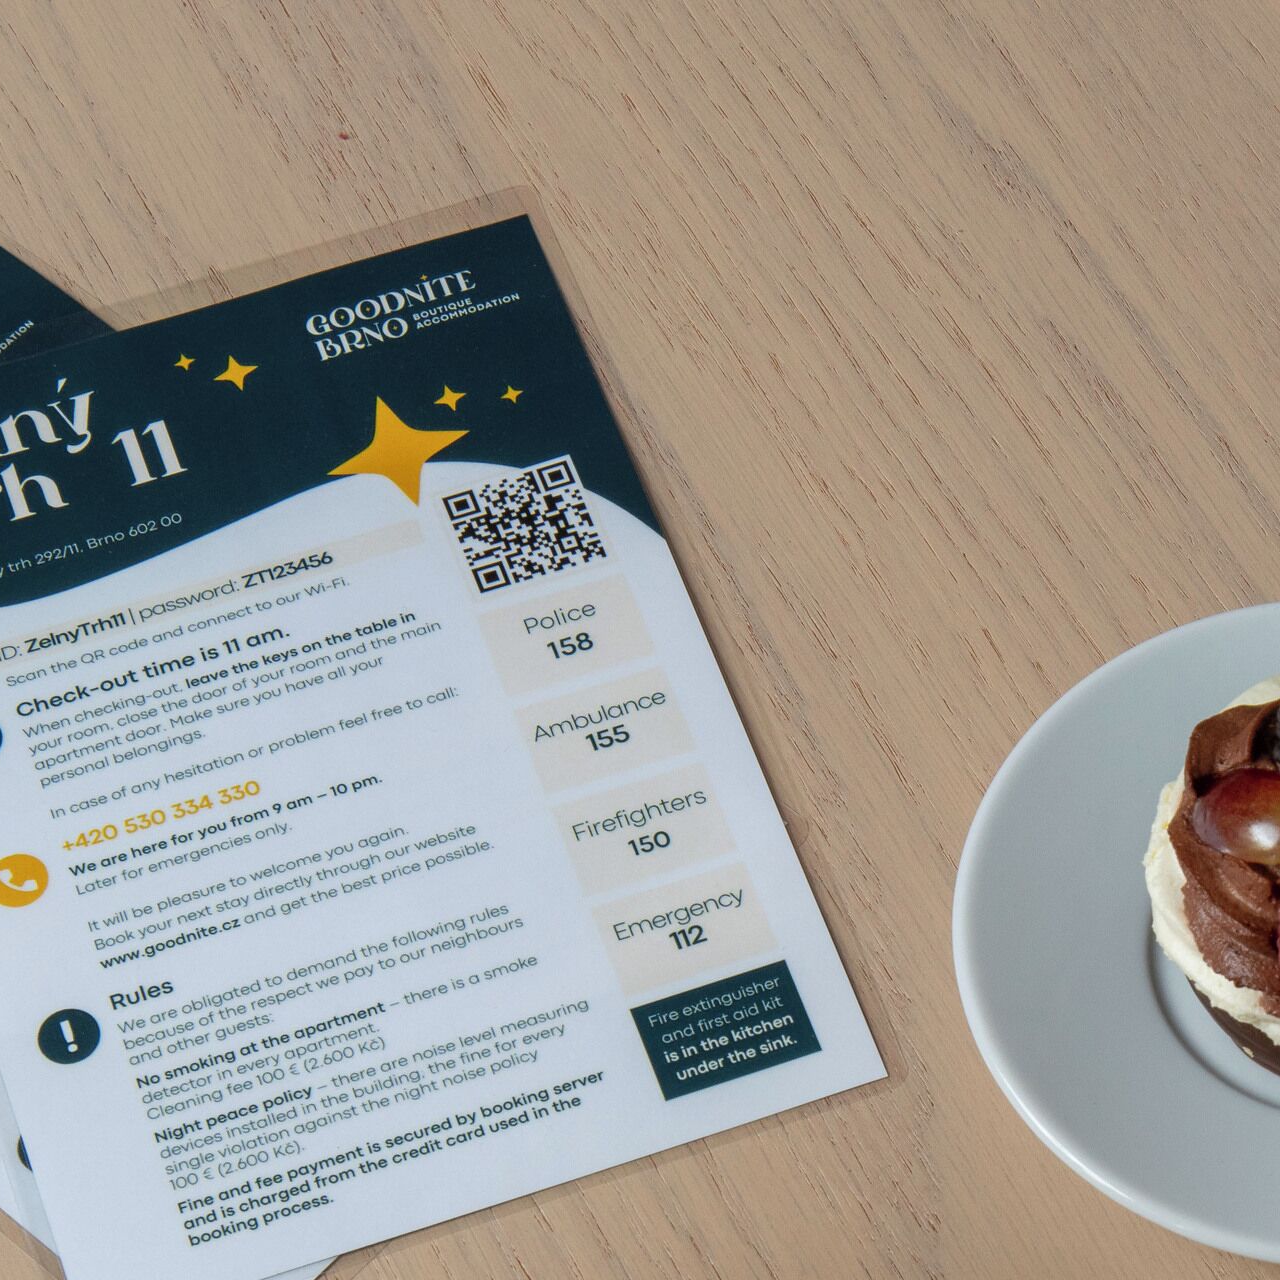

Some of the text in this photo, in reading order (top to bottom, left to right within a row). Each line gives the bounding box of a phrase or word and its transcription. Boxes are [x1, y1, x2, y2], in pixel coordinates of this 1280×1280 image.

[412, 297, 472, 321] BOUTIQUE
[416, 293, 520, 329] ACCOMMODATION
[314, 317, 408, 361] BRNO
[112, 419, 188, 486] 11
[7, 558, 32, 572] trh
[86, 532, 125, 549] Brno
[128, 520, 158, 537] 602
[160, 513, 182, 527] 00
[24, 612, 126, 653] ZelnyTrh11
[138, 579, 240, 622] password:
[240, 551, 334, 589] ZT123456
[523, 604, 596, 634] Police
[5, 577, 349, 687] Scan the QR code and connect to our Wi-Fi.
[546, 632, 593, 659] 158
[15, 628, 290, 717] Check-out time is 11 am.
[34, 657, 383, 771] apartment door. Make sure you have all your
[534, 692, 666, 742] Ambulance
[585, 724, 630, 751] 155
[39, 730, 205, 789] personal belongings.
[62, 780, 261, 851] +420 530 334 330
[68, 862, 97, 876] We
[100, 853, 127, 868] are
[130, 840, 167, 858] here
[170, 832, 194, 846] for
[197, 822, 227, 840] you
[229, 809, 270, 827] from
[272, 803, 282, 814] 9
[286, 796, 313, 810] am
[329, 783, 348, 796] 10
[351, 776, 382, 793] pm.
[571, 791, 707, 842] Firefighters
[75, 823, 292, 895] Later for emergencies only.
[627, 831, 671, 856] 150
[93, 825, 476, 951] Book your next stay directly through our website
[99, 842, 495, 969] www.goodnite.cz and get the best price possible.
[612, 889, 743, 941] Emergency
[668, 924, 708, 950] 112
[109, 981, 174, 1010] Rules
[647, 977, 779, 1027] Fire extinguisher
[661, 996, 783, 1044] and first aid kit
[663, 1015, 794, 1063] is in the kitchen
[676, 1034, 797, 1080] under the sink.
[177, 1071, 603, 1214] Fine and fee payment is secured by booking server
[183, 1097, 581, 1230] and is charged from the credit card used in the
[187, 1195, 334, 1247] booking process.
